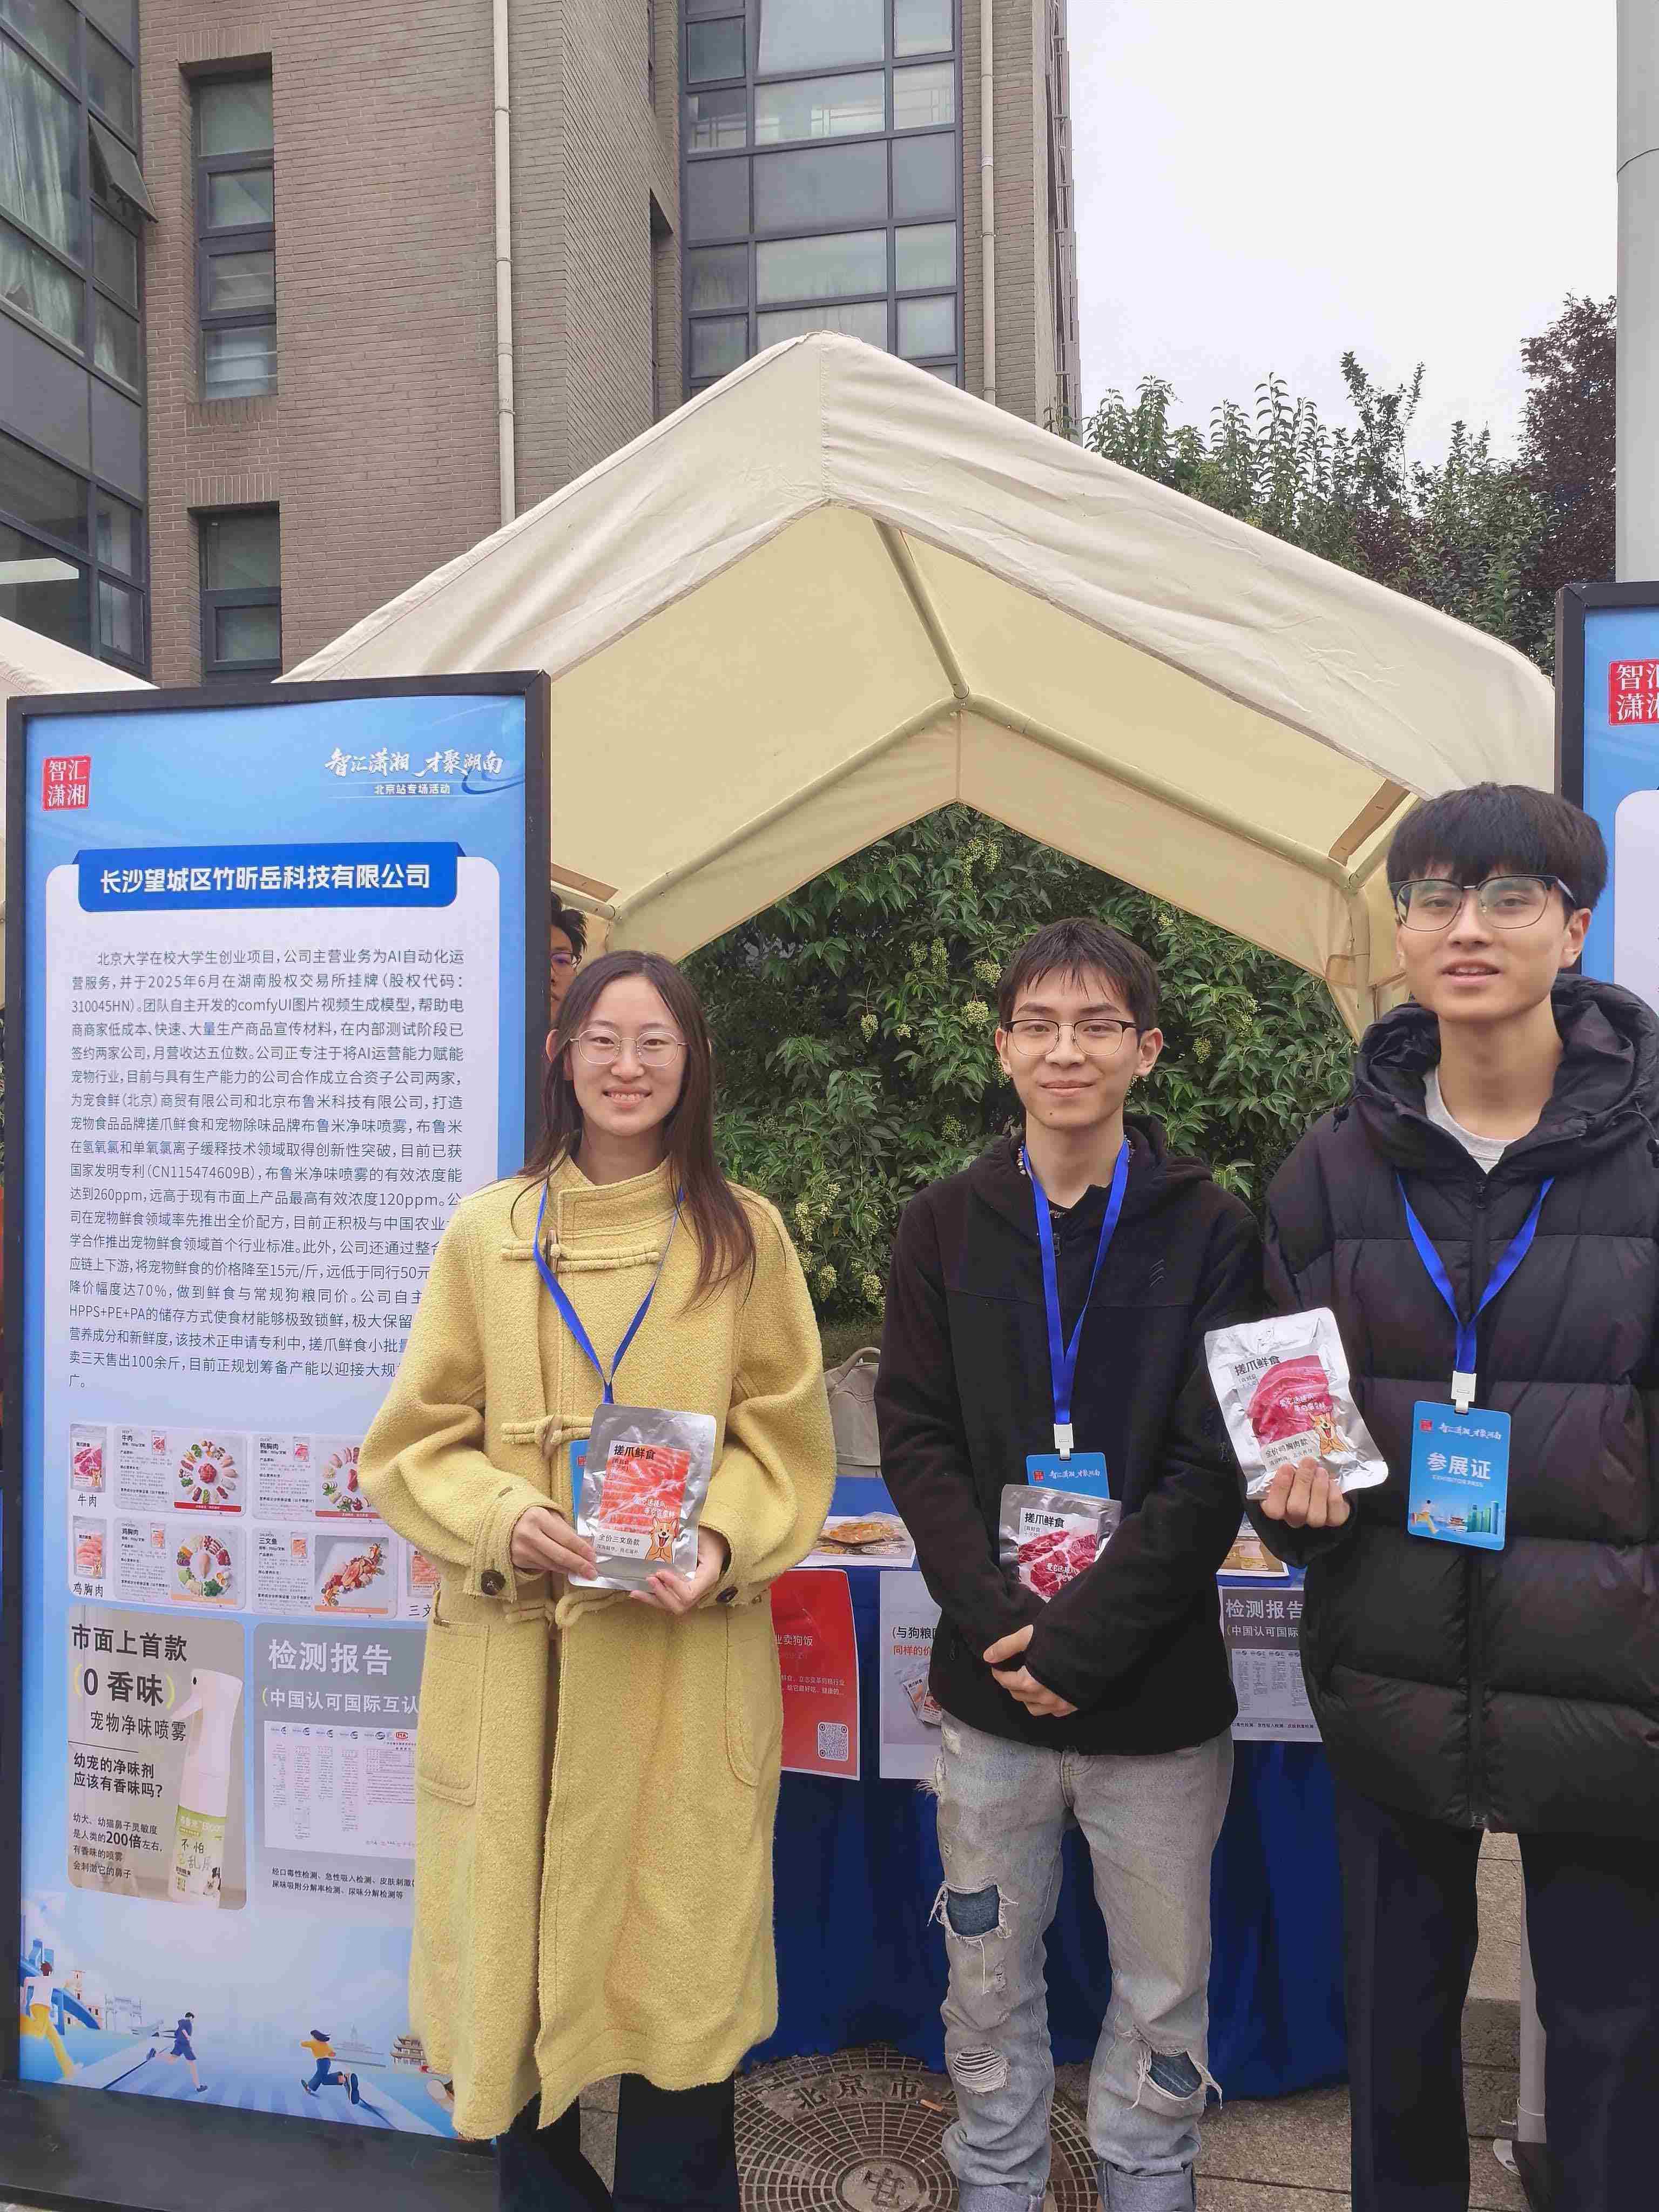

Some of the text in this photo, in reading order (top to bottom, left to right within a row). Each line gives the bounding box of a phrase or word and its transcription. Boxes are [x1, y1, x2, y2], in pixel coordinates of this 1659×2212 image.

[48, 759, 87, 781] 智汇
[325, 747, 504, 777] 智汇潇湘 才聚湖南
[47, 784, 86, 807] 潇湘
[374, 783, 451, 795] 北京站专场活动
[100, 864, 430, 894] 长沙望城区竹昕岳科技有限公司
[97, 949, 464, 966] 北京大学在校大学生创业项目，公司主营业务为AI自动化运
[70, 1210, 449, 1231] 司在宠物鲜食领域率先推出全价配方，目前正积极与中国农业
[69, 1352, 401, 1377] 卖三天售出100余斤，目前正规划筹备产能以迎接大规
[1235, 1355, 1280, 1376] 搓爪鲜食
[614, 1444, 656, 1460] 搓爪鲜食
[1427, 1452, 1491, 1480] 参展证
[77, 1494, 97, 1508] 牛肉
[1024, 1512, 1065, 1528] 搓爪鲜食
[599, 1533, 640, 1547] 全价三文鱼款
[73, 1583, 104, 1598] 鸡胸肉
[1225, 1599, 1304, 1620] 检测报告
[71, 1623, 188, 1662] 市面上首款
[892, 1626, 938, 1640] （与狗粮
[268, 1639, 392, 1675] 检测报告
[893, 1645, 933, 1656] 同样的价
[90, 1710, 186, 1742] 宠物净味喷雾
[73, 1752, 154, 1779] 幼宠的净味剂
[73, 1772, 163, 1798] 应该有香味吗？
[73, 1845, 123, 1863] 有香味的喷雾
